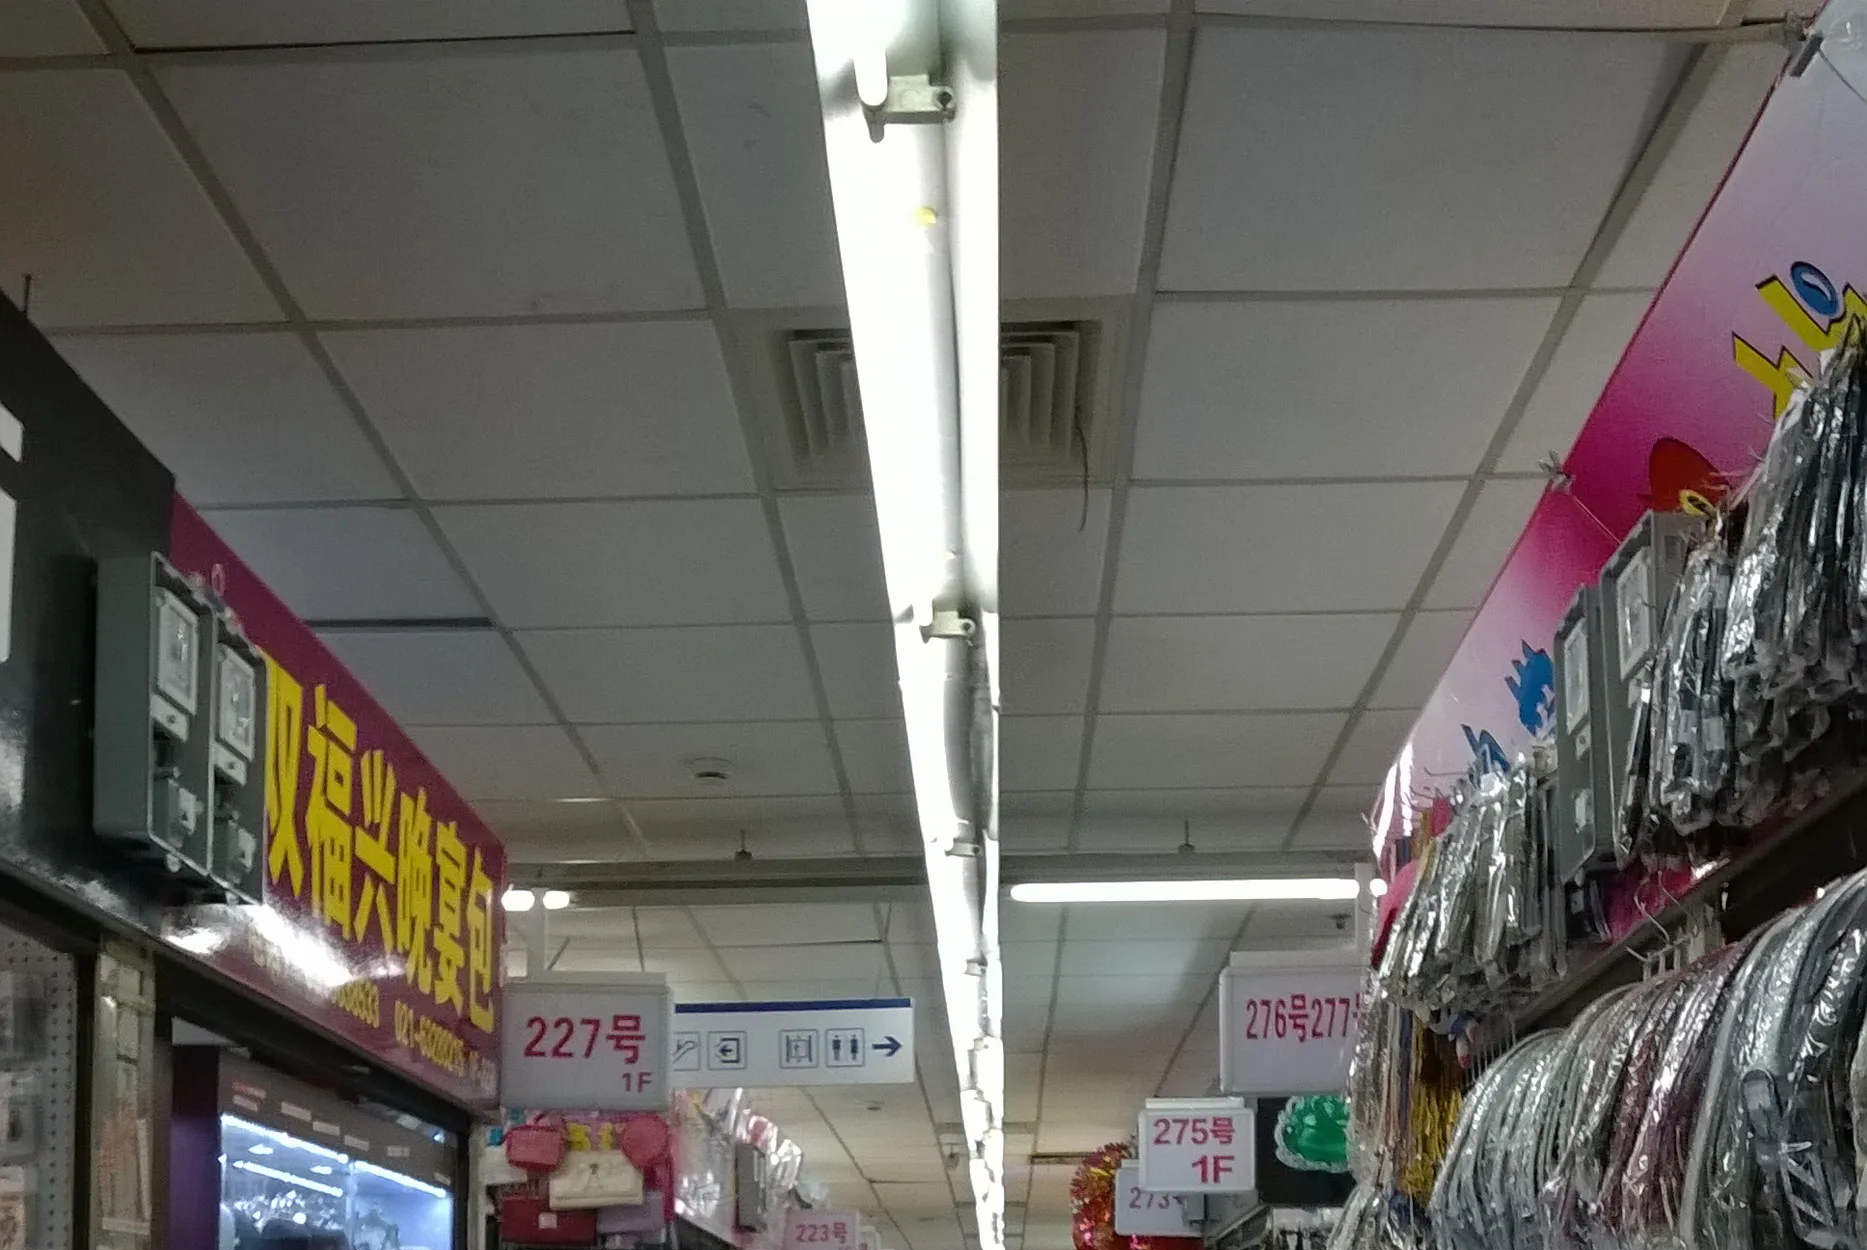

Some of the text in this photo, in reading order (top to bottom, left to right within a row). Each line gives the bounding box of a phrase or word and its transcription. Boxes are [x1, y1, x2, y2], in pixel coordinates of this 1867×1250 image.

[523, 1014, 647, 1065] 227号
[621, 1071, 653, 1093] 1F
[1152, 1116, 1236, 1146] 275号
[1190, 1154, 1236, 1184] 1F
[1128, 1186, 1187, 1210] 273
[795, 1221, 848, 1244] 223号
